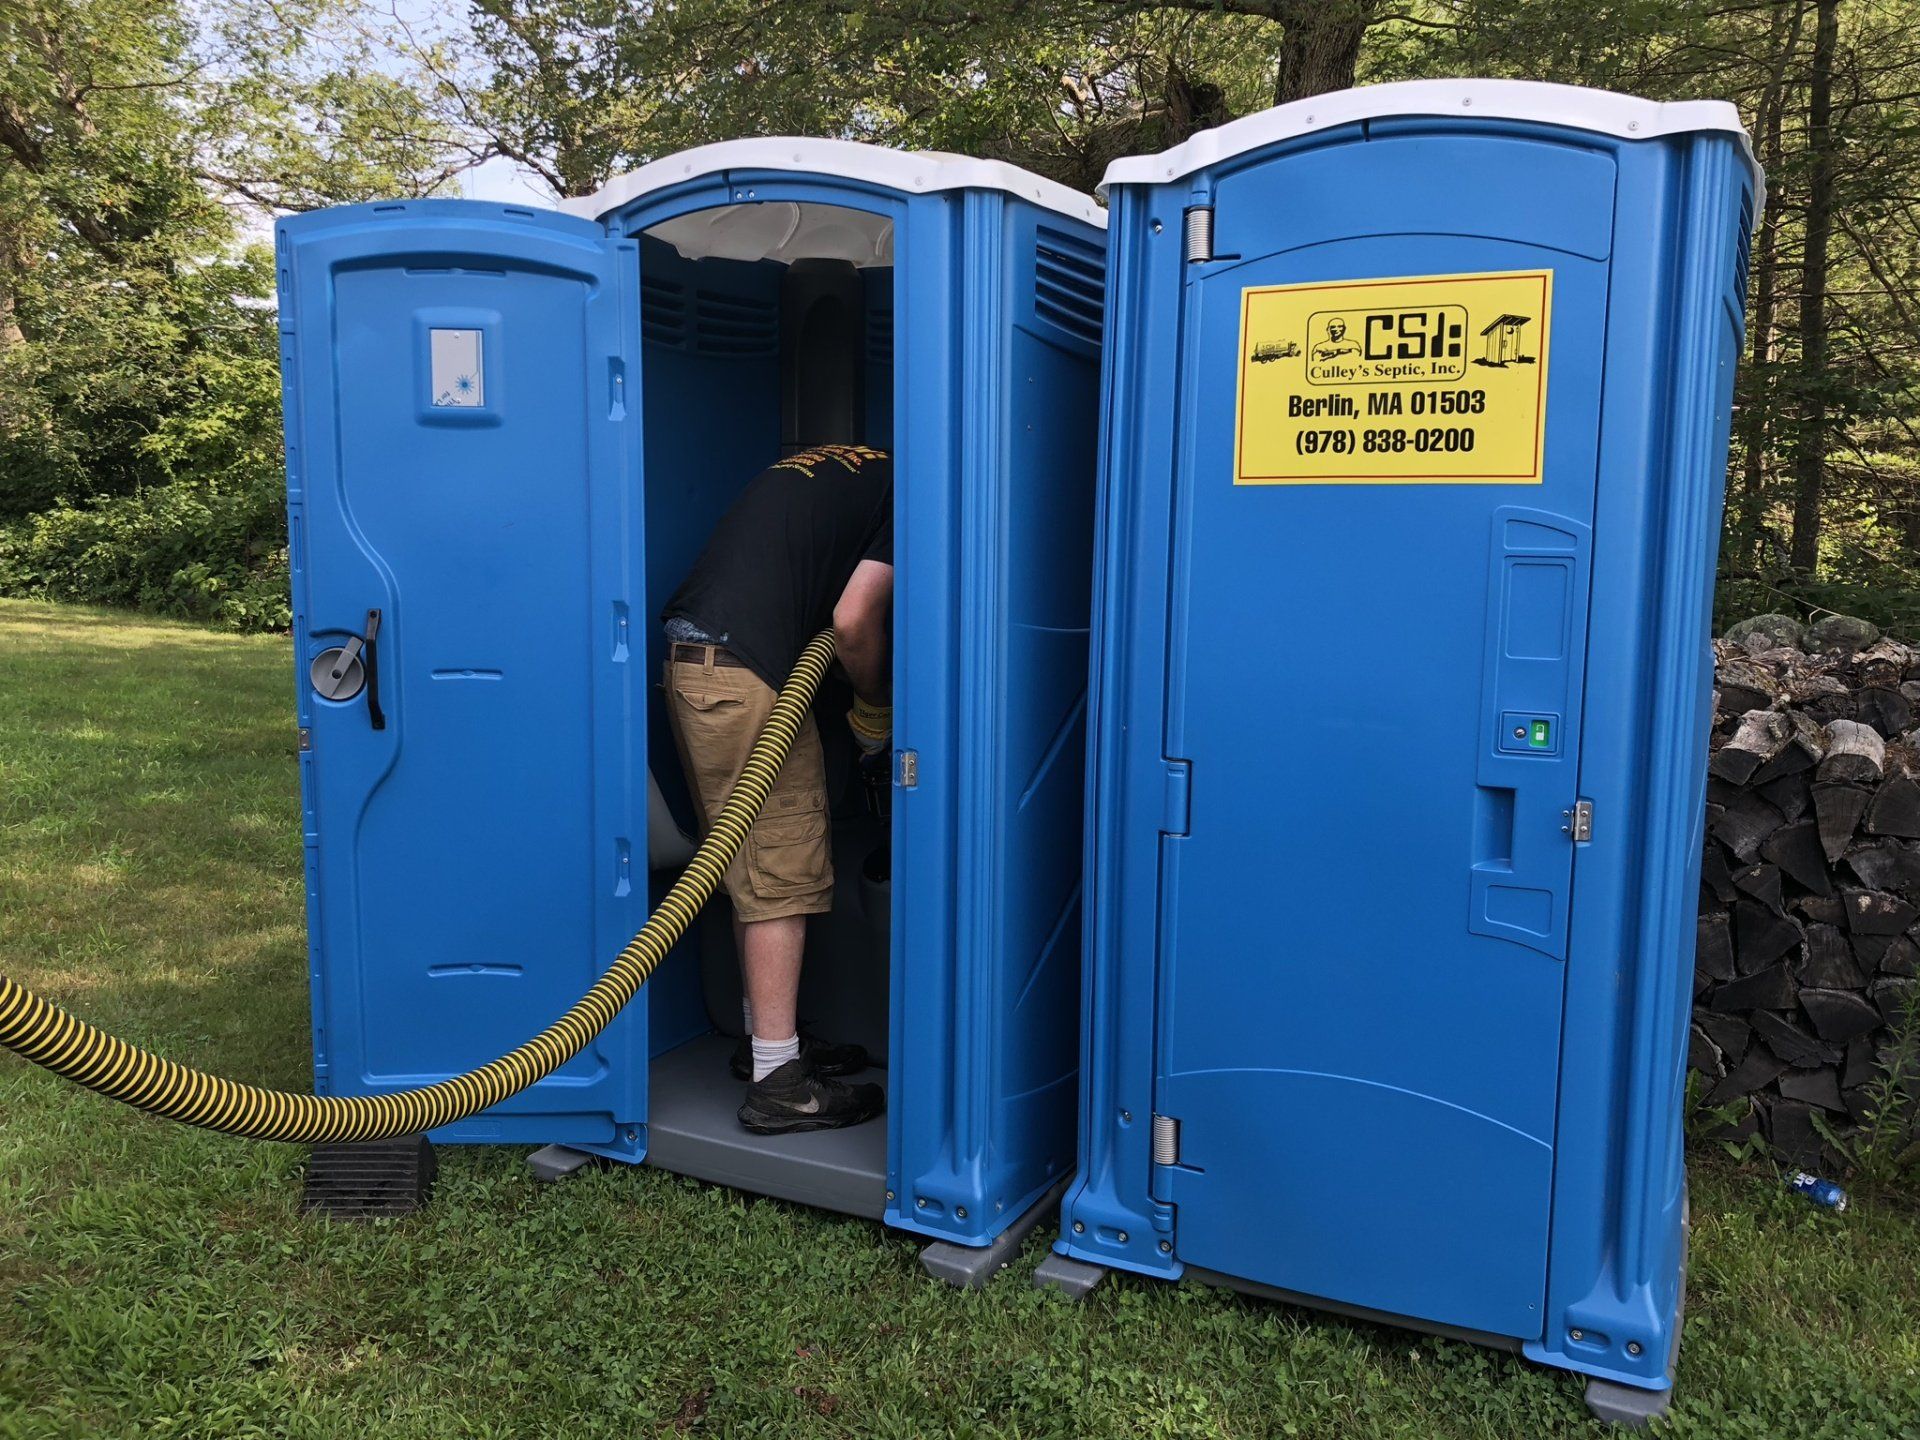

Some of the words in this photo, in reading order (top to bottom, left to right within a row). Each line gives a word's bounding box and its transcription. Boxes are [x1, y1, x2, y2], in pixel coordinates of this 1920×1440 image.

[1310, 365, 1370, 381] Culley's
[1374, 363, 1426, 379] Septic,
[1431, 362, 1461, 375] Inc.
[1288, 393, 1360, 420] Berlin,
[1367, 392, 1403, 416] MA
[1410, 389, 1486, 415] 01503
[1295, 429, 1356, 456] (978)
[1362, 427, 1475, 454] 838-0200
